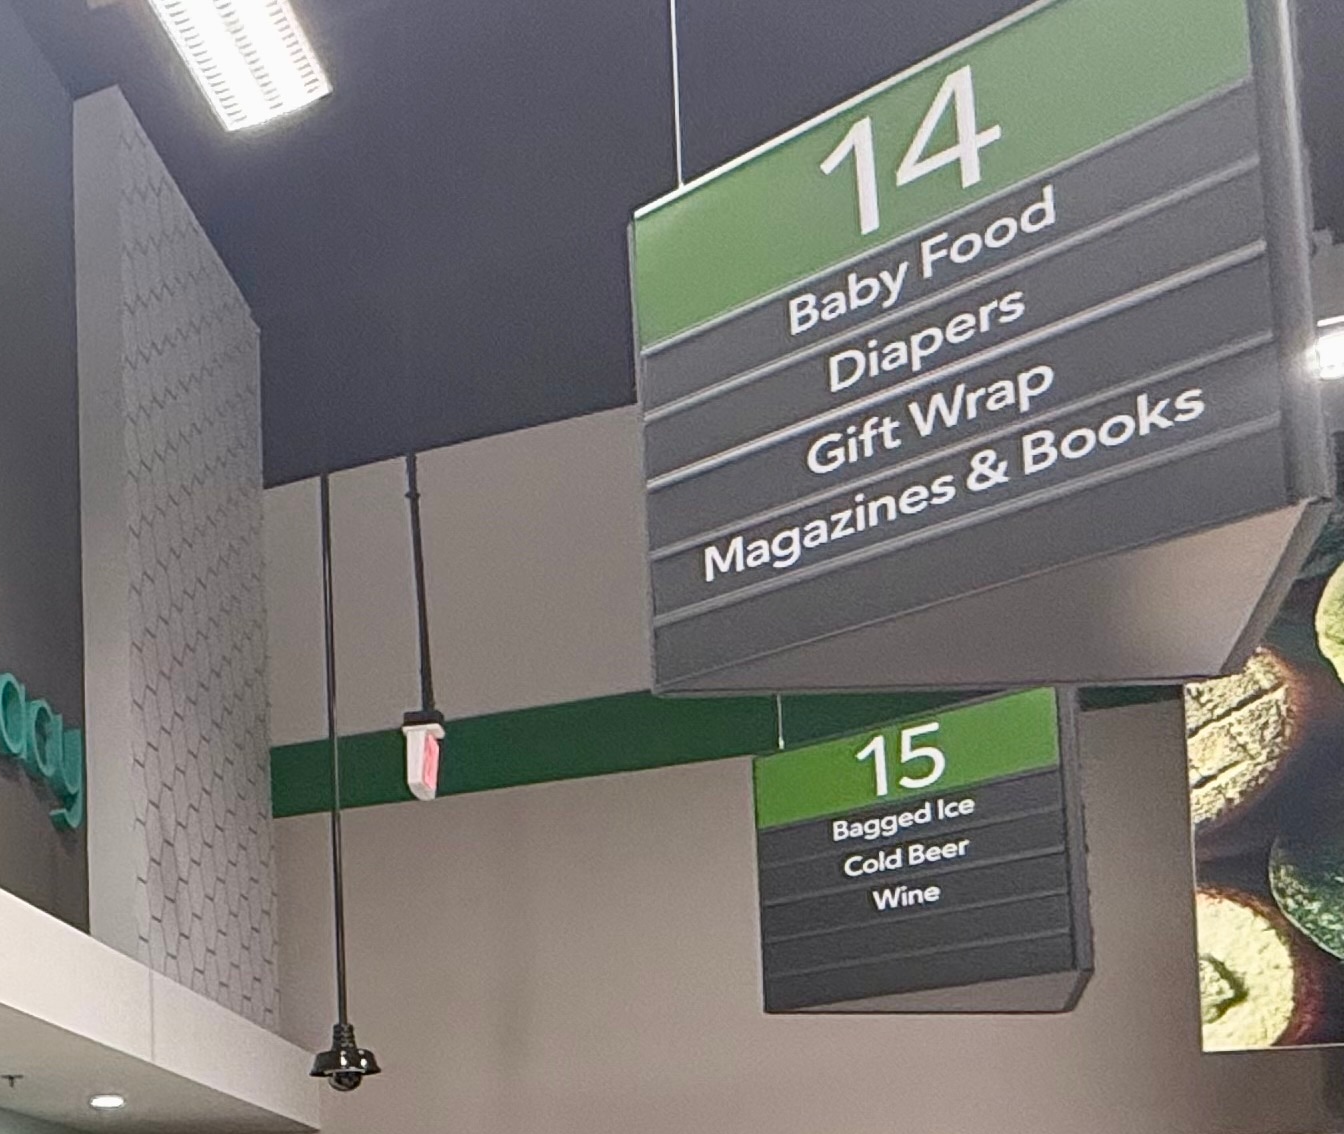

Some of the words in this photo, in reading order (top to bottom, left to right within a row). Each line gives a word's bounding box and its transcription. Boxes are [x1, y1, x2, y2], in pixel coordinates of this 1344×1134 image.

[820, 65, 1002, 235] 14
[788, 261, 909, 336] Baby
[920, 184, 1057, 279] Food
[827, 290, 1025, 393] Diapers
[806, 411, 902, 475] Gift
[909, 364, 1054, 437] Wrap
[704, 478, 956, 582] Magazines
[967, 448, 1008, 492] &
[1023, 388, 1205, 476] Books
[856, 722, 946, 797] 15
[832, 802, 932, 843] Bagged
[937, 795, 976, 823] Ice
[843, 850, 903, 878] Cold
[908, 835, 970, 865] Beer
[872, 882, 941, 912] Wine
